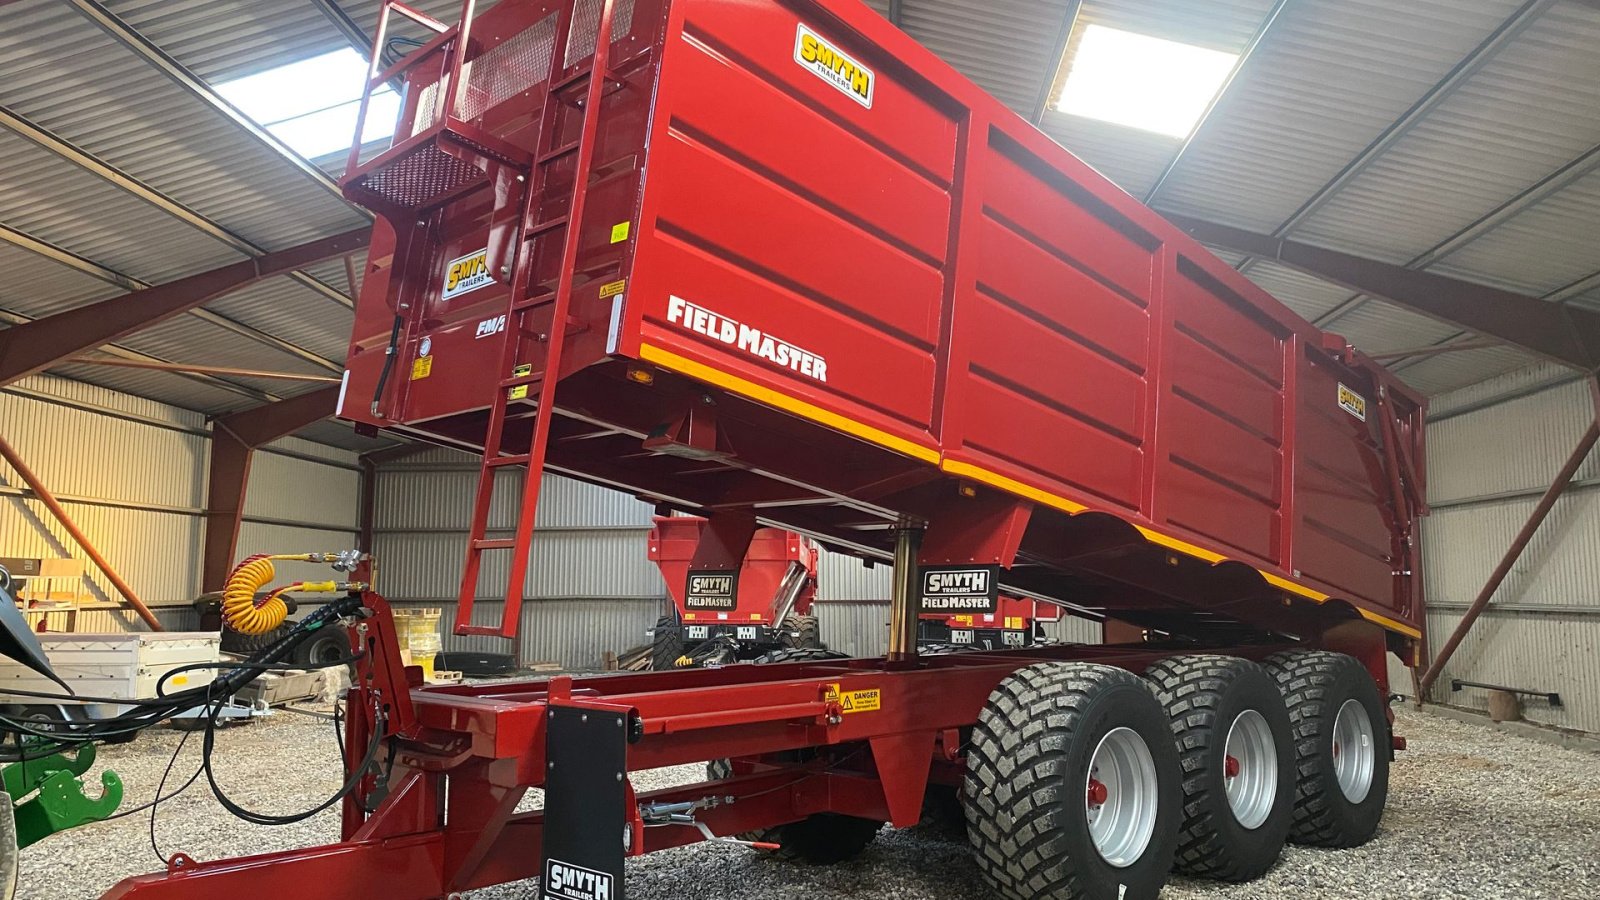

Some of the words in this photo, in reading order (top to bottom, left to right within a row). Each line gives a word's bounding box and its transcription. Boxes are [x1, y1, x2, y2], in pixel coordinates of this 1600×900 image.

[801, 34, 869, 100] SMYTH
[817, 63, 850, 90] TRAILERS
[447, 254, 491, 292] SMYT
[1340, 387, 1364, 417] SMYTH
[692, 577, 730, 593] SMYTH
[929, 573, 986, 592] SMYTH
[854, 691, 878, 700] DANGER
[551, 864, 609, 900] SMYTH
[564, 887, 594, 900] TRAILERS
